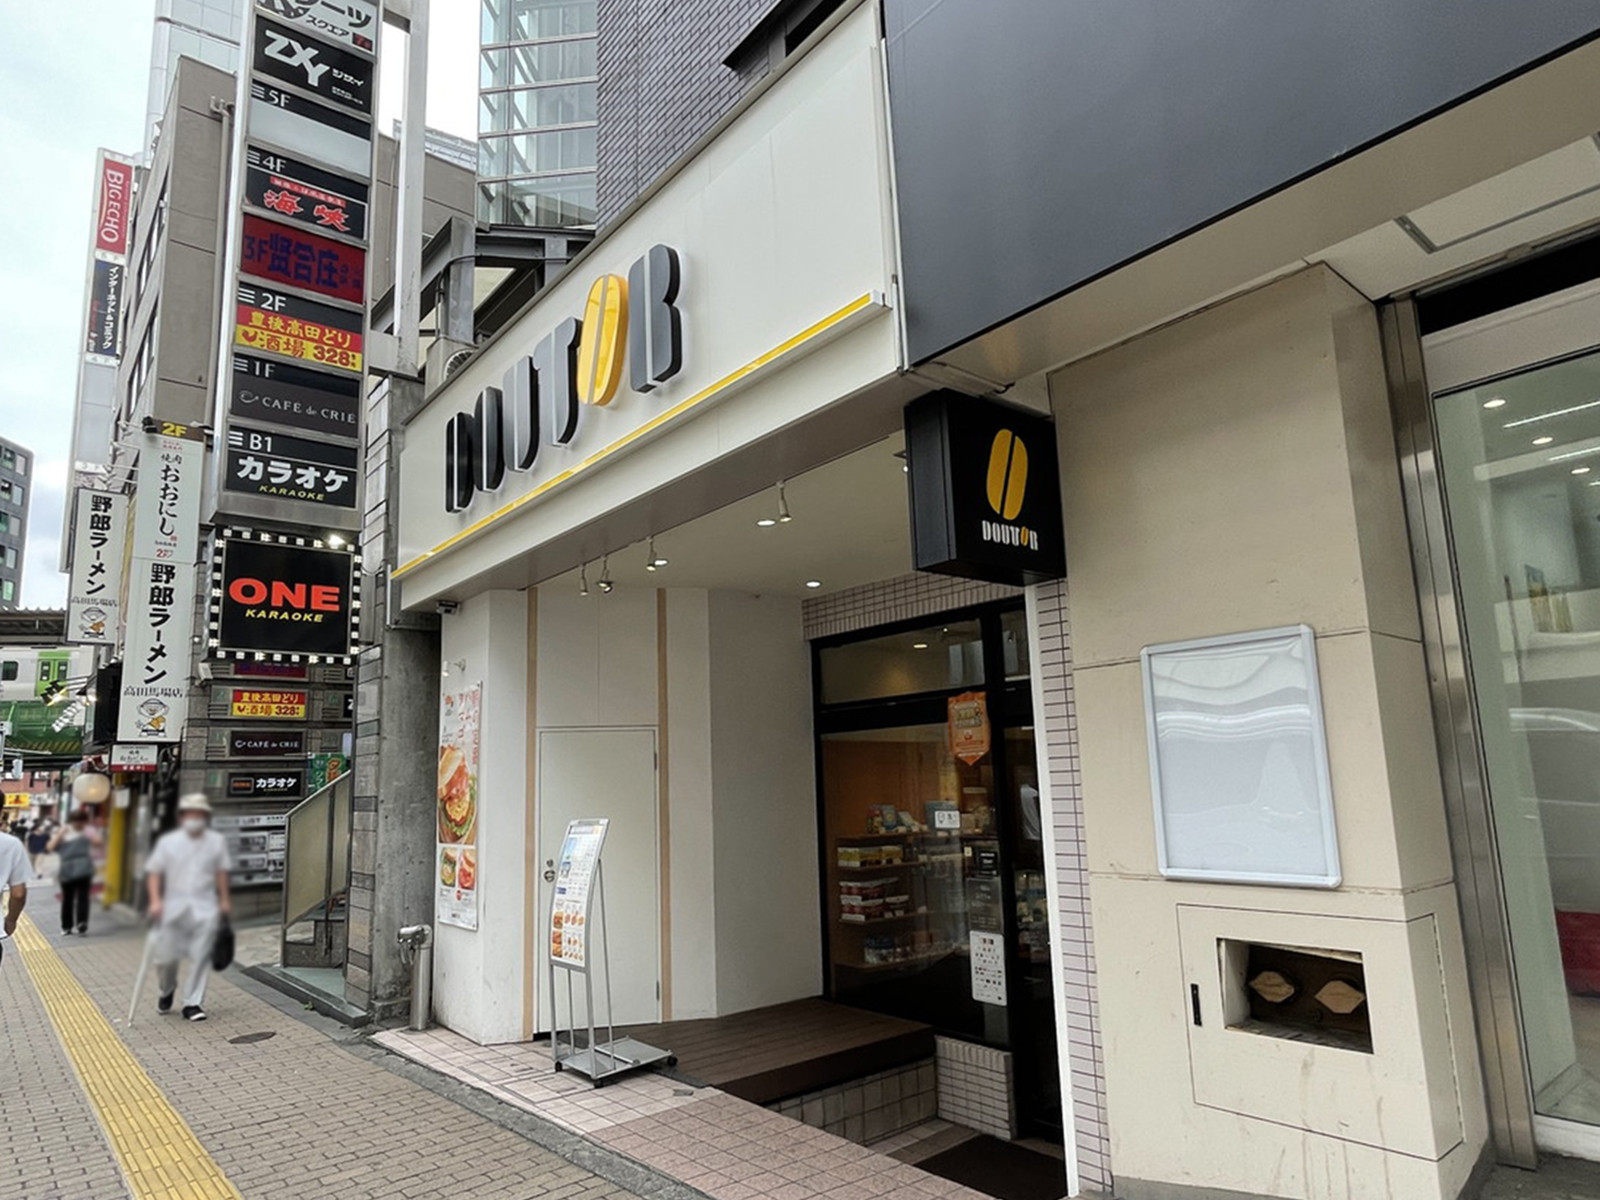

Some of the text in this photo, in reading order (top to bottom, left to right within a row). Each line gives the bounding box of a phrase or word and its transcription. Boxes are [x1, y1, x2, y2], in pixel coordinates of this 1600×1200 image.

[305, 14, 350, 37] スクエア
[268, 90, 291, 108] 5F
[262, 156, 287, 173] 4F
[105, 168, 124, 199] BIG
[101, 201, 121, 243] ECHO
[260, 292, 287, 312] 2F
[248, 311, 351, 348] 豊後高田どり
[259, 331, 305, 359] 酒場
[313, 345, 351, 367] 328
[254, 361, 276, 378] 1F
[446, 243, 683, 514] DOUTOR
[305, 406, 317, 416] de
[162, 422, 188, 437] 2F
[250, 433, 272, 453] B1
[237, 456, 348, 493] カラオケ
[158, 464, 180, 537] おおにし
[259, 485, 325, 501] KARAOKE
[86, 494, 113, 596] 野郎ラーメン
[981, 519, 1039, 551] DOUTOR
[229, 577, 340, 612] ONE
[143, 563, 176, 685] 野郎ラーメン
[245, 609, 324, 623] KARAOKE
[255, 777, 297, 789] カラオケ
